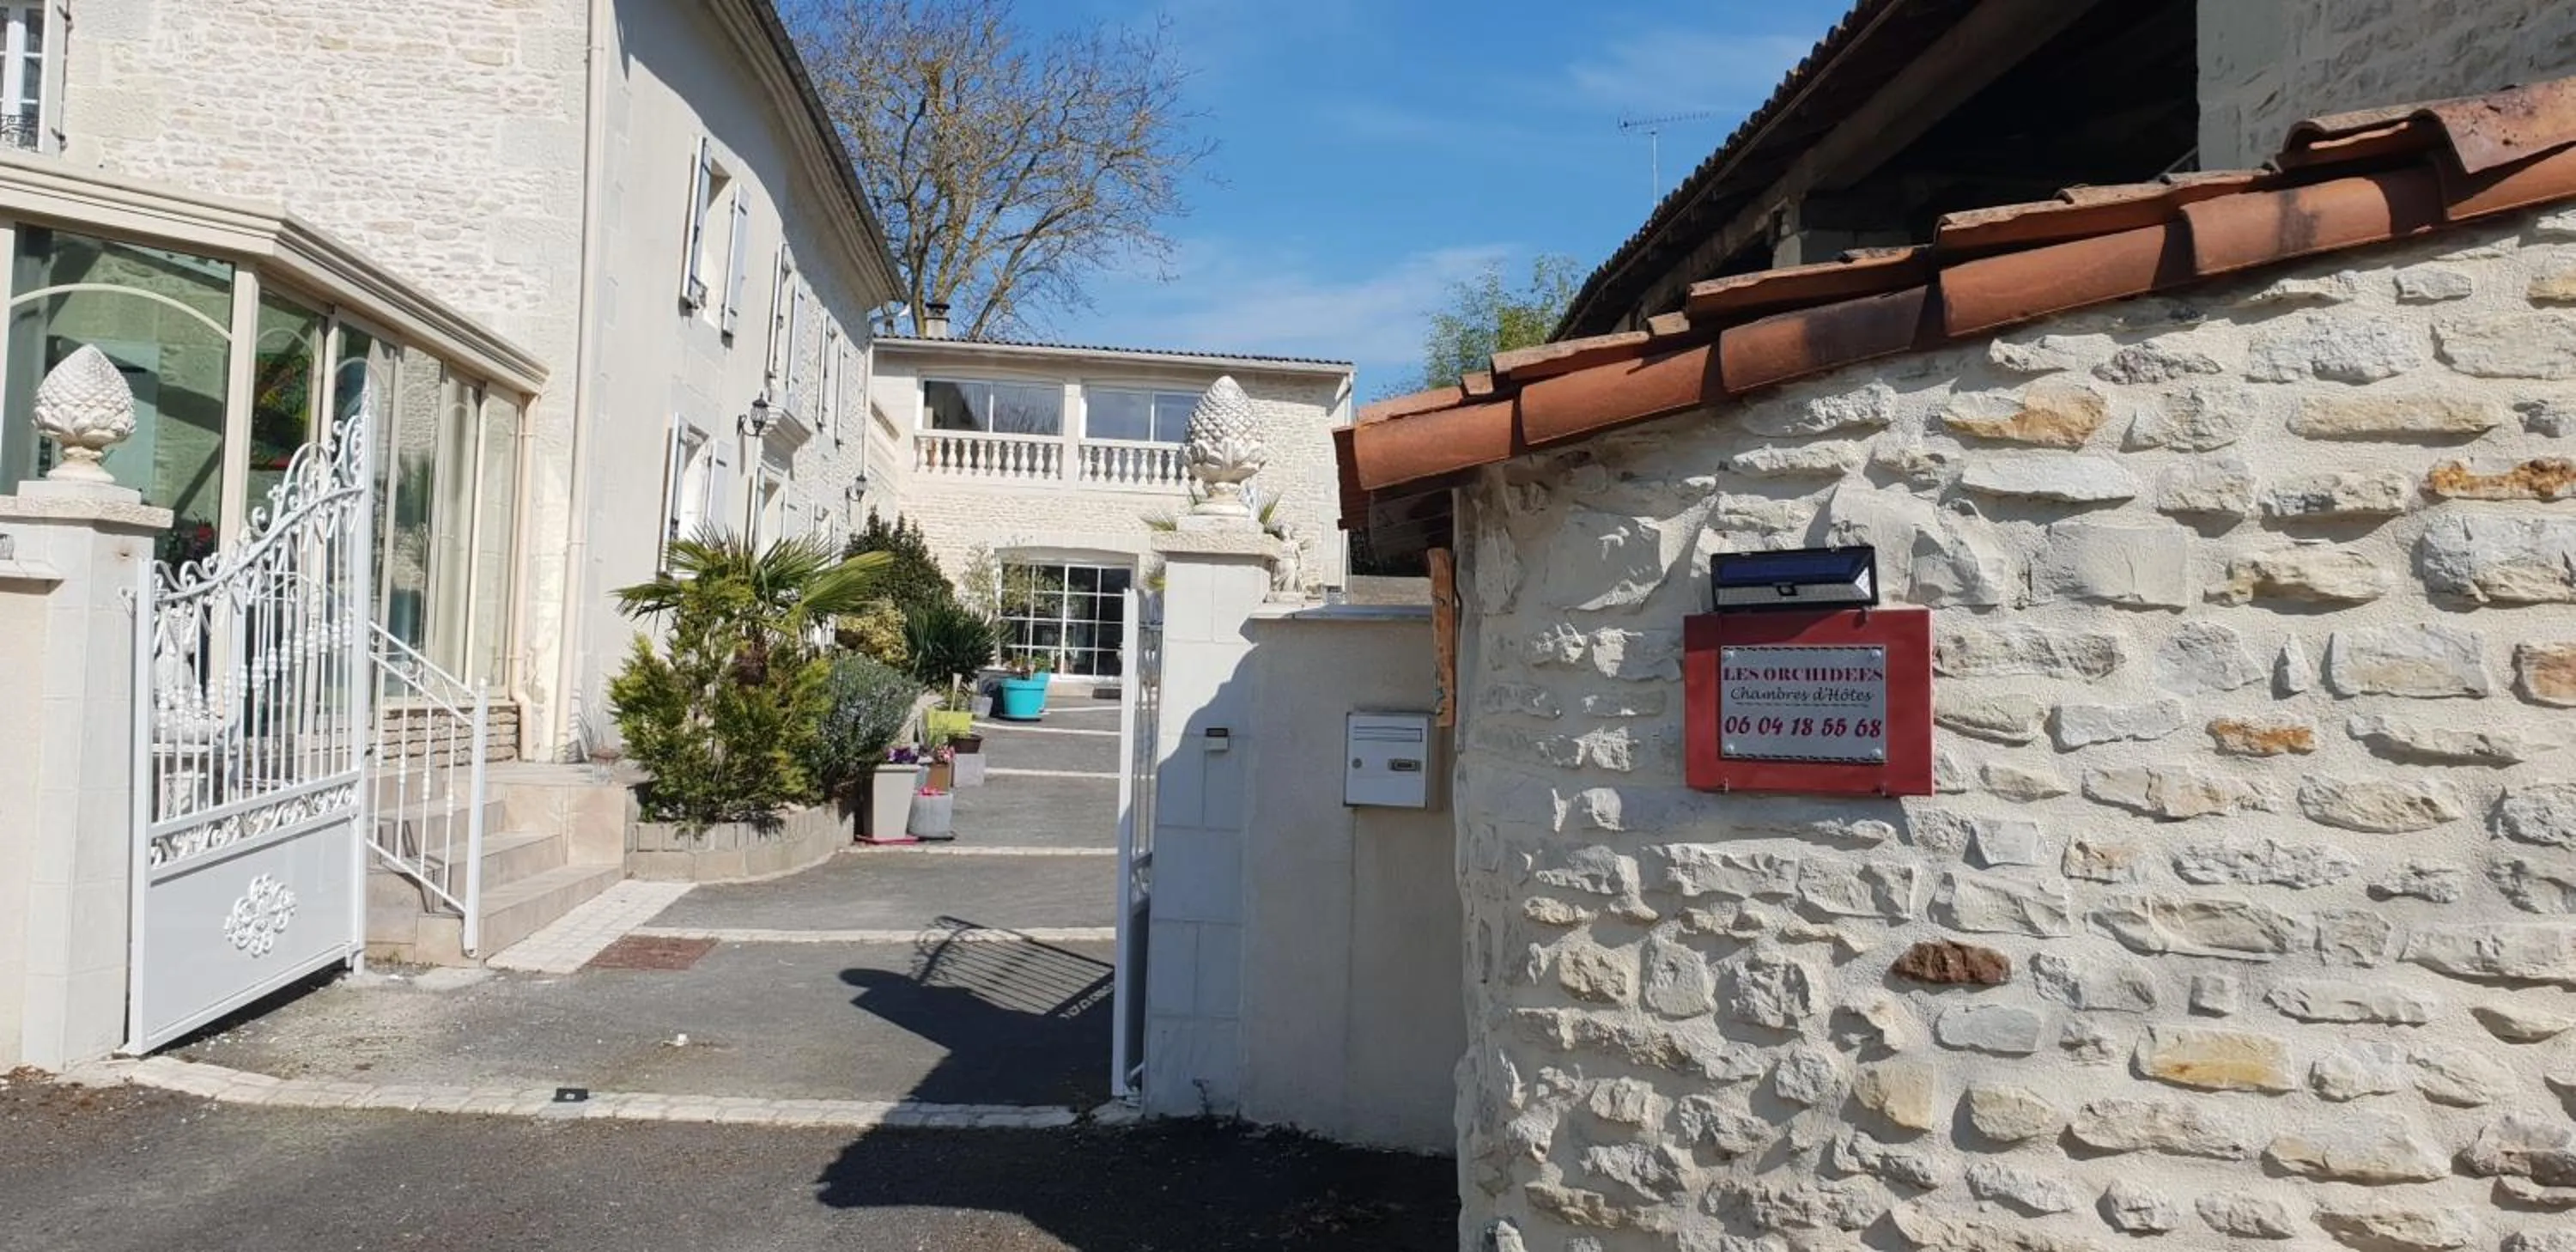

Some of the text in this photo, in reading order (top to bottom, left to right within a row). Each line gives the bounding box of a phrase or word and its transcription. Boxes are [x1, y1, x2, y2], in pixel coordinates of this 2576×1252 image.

[1723, 666, 1883, 681] LES ORCHIDEES
[1730, 686, 1874, 702] Chambres d'Hôtes
[1724, 715, 1881, 738] 06 04 18 55 68
